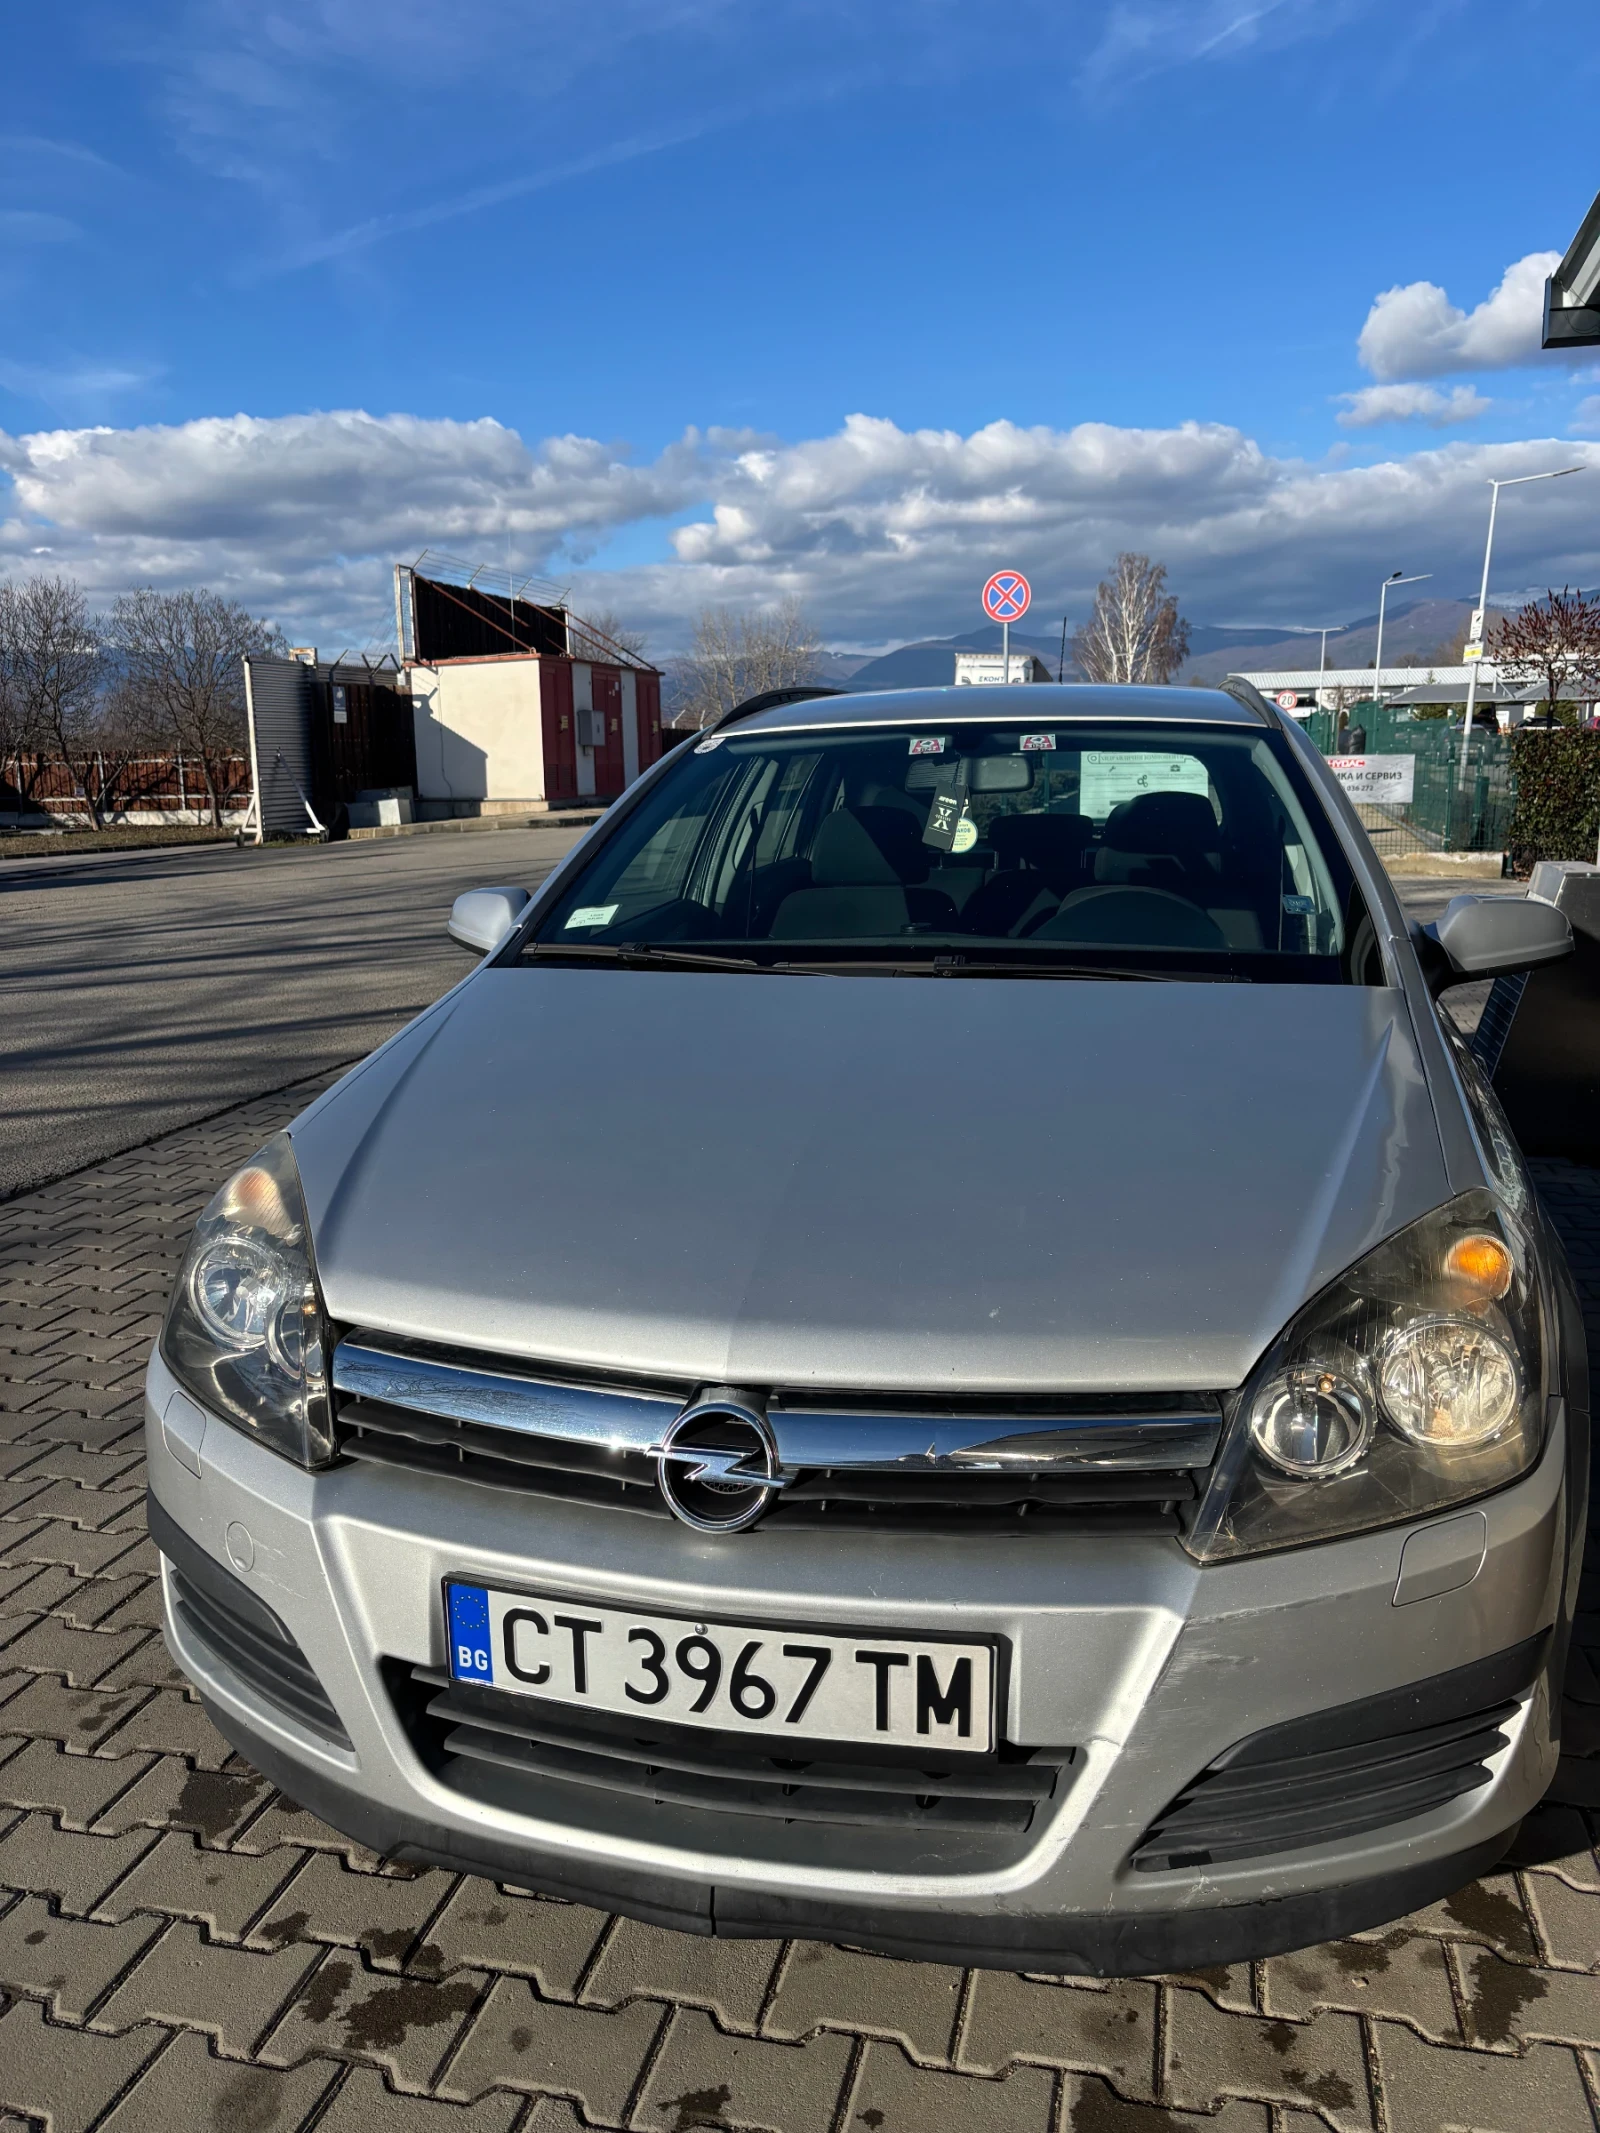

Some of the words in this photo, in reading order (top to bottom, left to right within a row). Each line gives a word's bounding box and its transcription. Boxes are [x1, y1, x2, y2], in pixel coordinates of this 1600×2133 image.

[1281, 695, 1293, 705] 20
[1327, 759, 1365, 768] HYDAC
[1356, 772, 1363, 780] И
[1365, 772, 1402, 780] СЕРВИЗ
[938, 796, 957, 805] areon
[458, 1645, 488, 1671] BG
[503, 1608, 602, 1694] CT
[624, 1628, 833, 1724] 3967
[856, 1650, 972, 1738] TM
